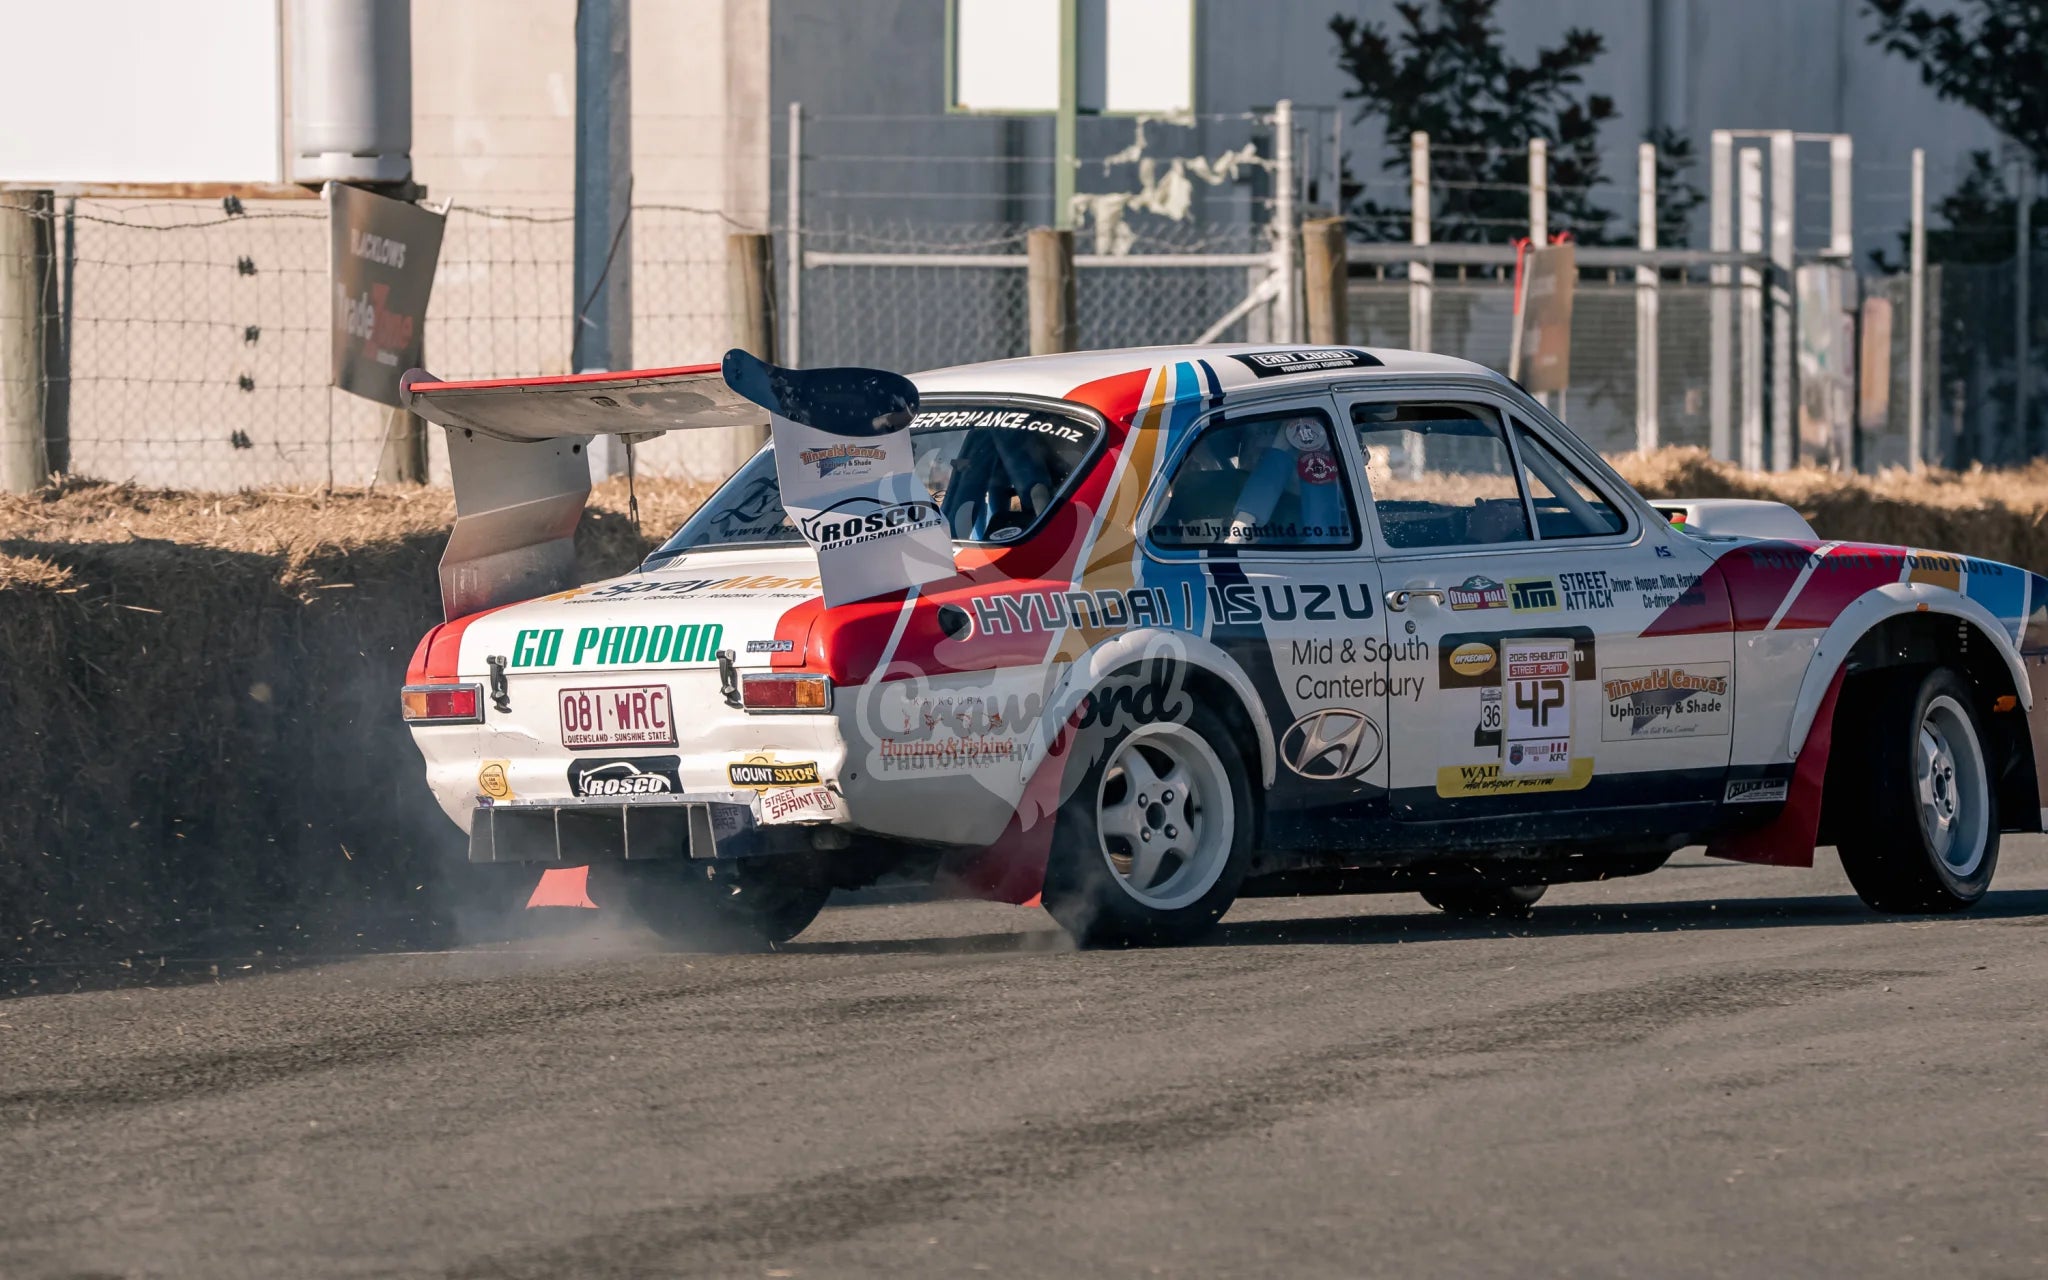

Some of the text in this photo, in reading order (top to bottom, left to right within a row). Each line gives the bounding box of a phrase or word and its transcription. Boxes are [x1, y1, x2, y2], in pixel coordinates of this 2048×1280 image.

[1256, 351, 1298, 365] EAST
[800, 443, 887, 465] Tinwald Canvas
[854, 459, 872, 467] Shade
[820, 518, 942, 552] AUTO DISMANTLERS
[821, 505, 927, 544] ROSCO
[1559, 571, 1608, 592] STREET
[1450, 590, 1481, 605] OTAGO
[1566, 589, 1614, 611] ATTACK
[973, 587, 1174, 635] HYUNDAI
[1208, 583, 1374, 626] ISUZU
[511, 624, 724, 668] GO PADDON
[1292, 635, 1429, 665] Mid & South
[1509, 651, 1568, 663] 2026 ASHBURTON
[1511, 663, 1564, 675] STREET SPRINT
[1296, 671, 1425, 702] Canterbury
[1604, 668, 1728, 702] Tinwald Canvas
[564, 691, 666, 732] 081 WRC
[913, 696, 983, 706] KAIKOURA
[1610, 699, 1722, 722] Upholstery & Shade
[1483, 705, 1500, 728] 36
[567, 733, 608, 743] QUEENSLAND
[614, 732, 645, 742] SUNSHINE
[648, 731, 667, 741] STATE
[880, 738, 944, 760] Hunting
[960, 735, 1014, 759] Fishing
[1549, 753, 1567, 763] KFC
[731, 767, 817, 782] MOUNT SHOP
[588, 778, 663, 796] ROSCO
[764, 788, 796, 808] STREET
[771, 793, 815, 820] SPRINT
